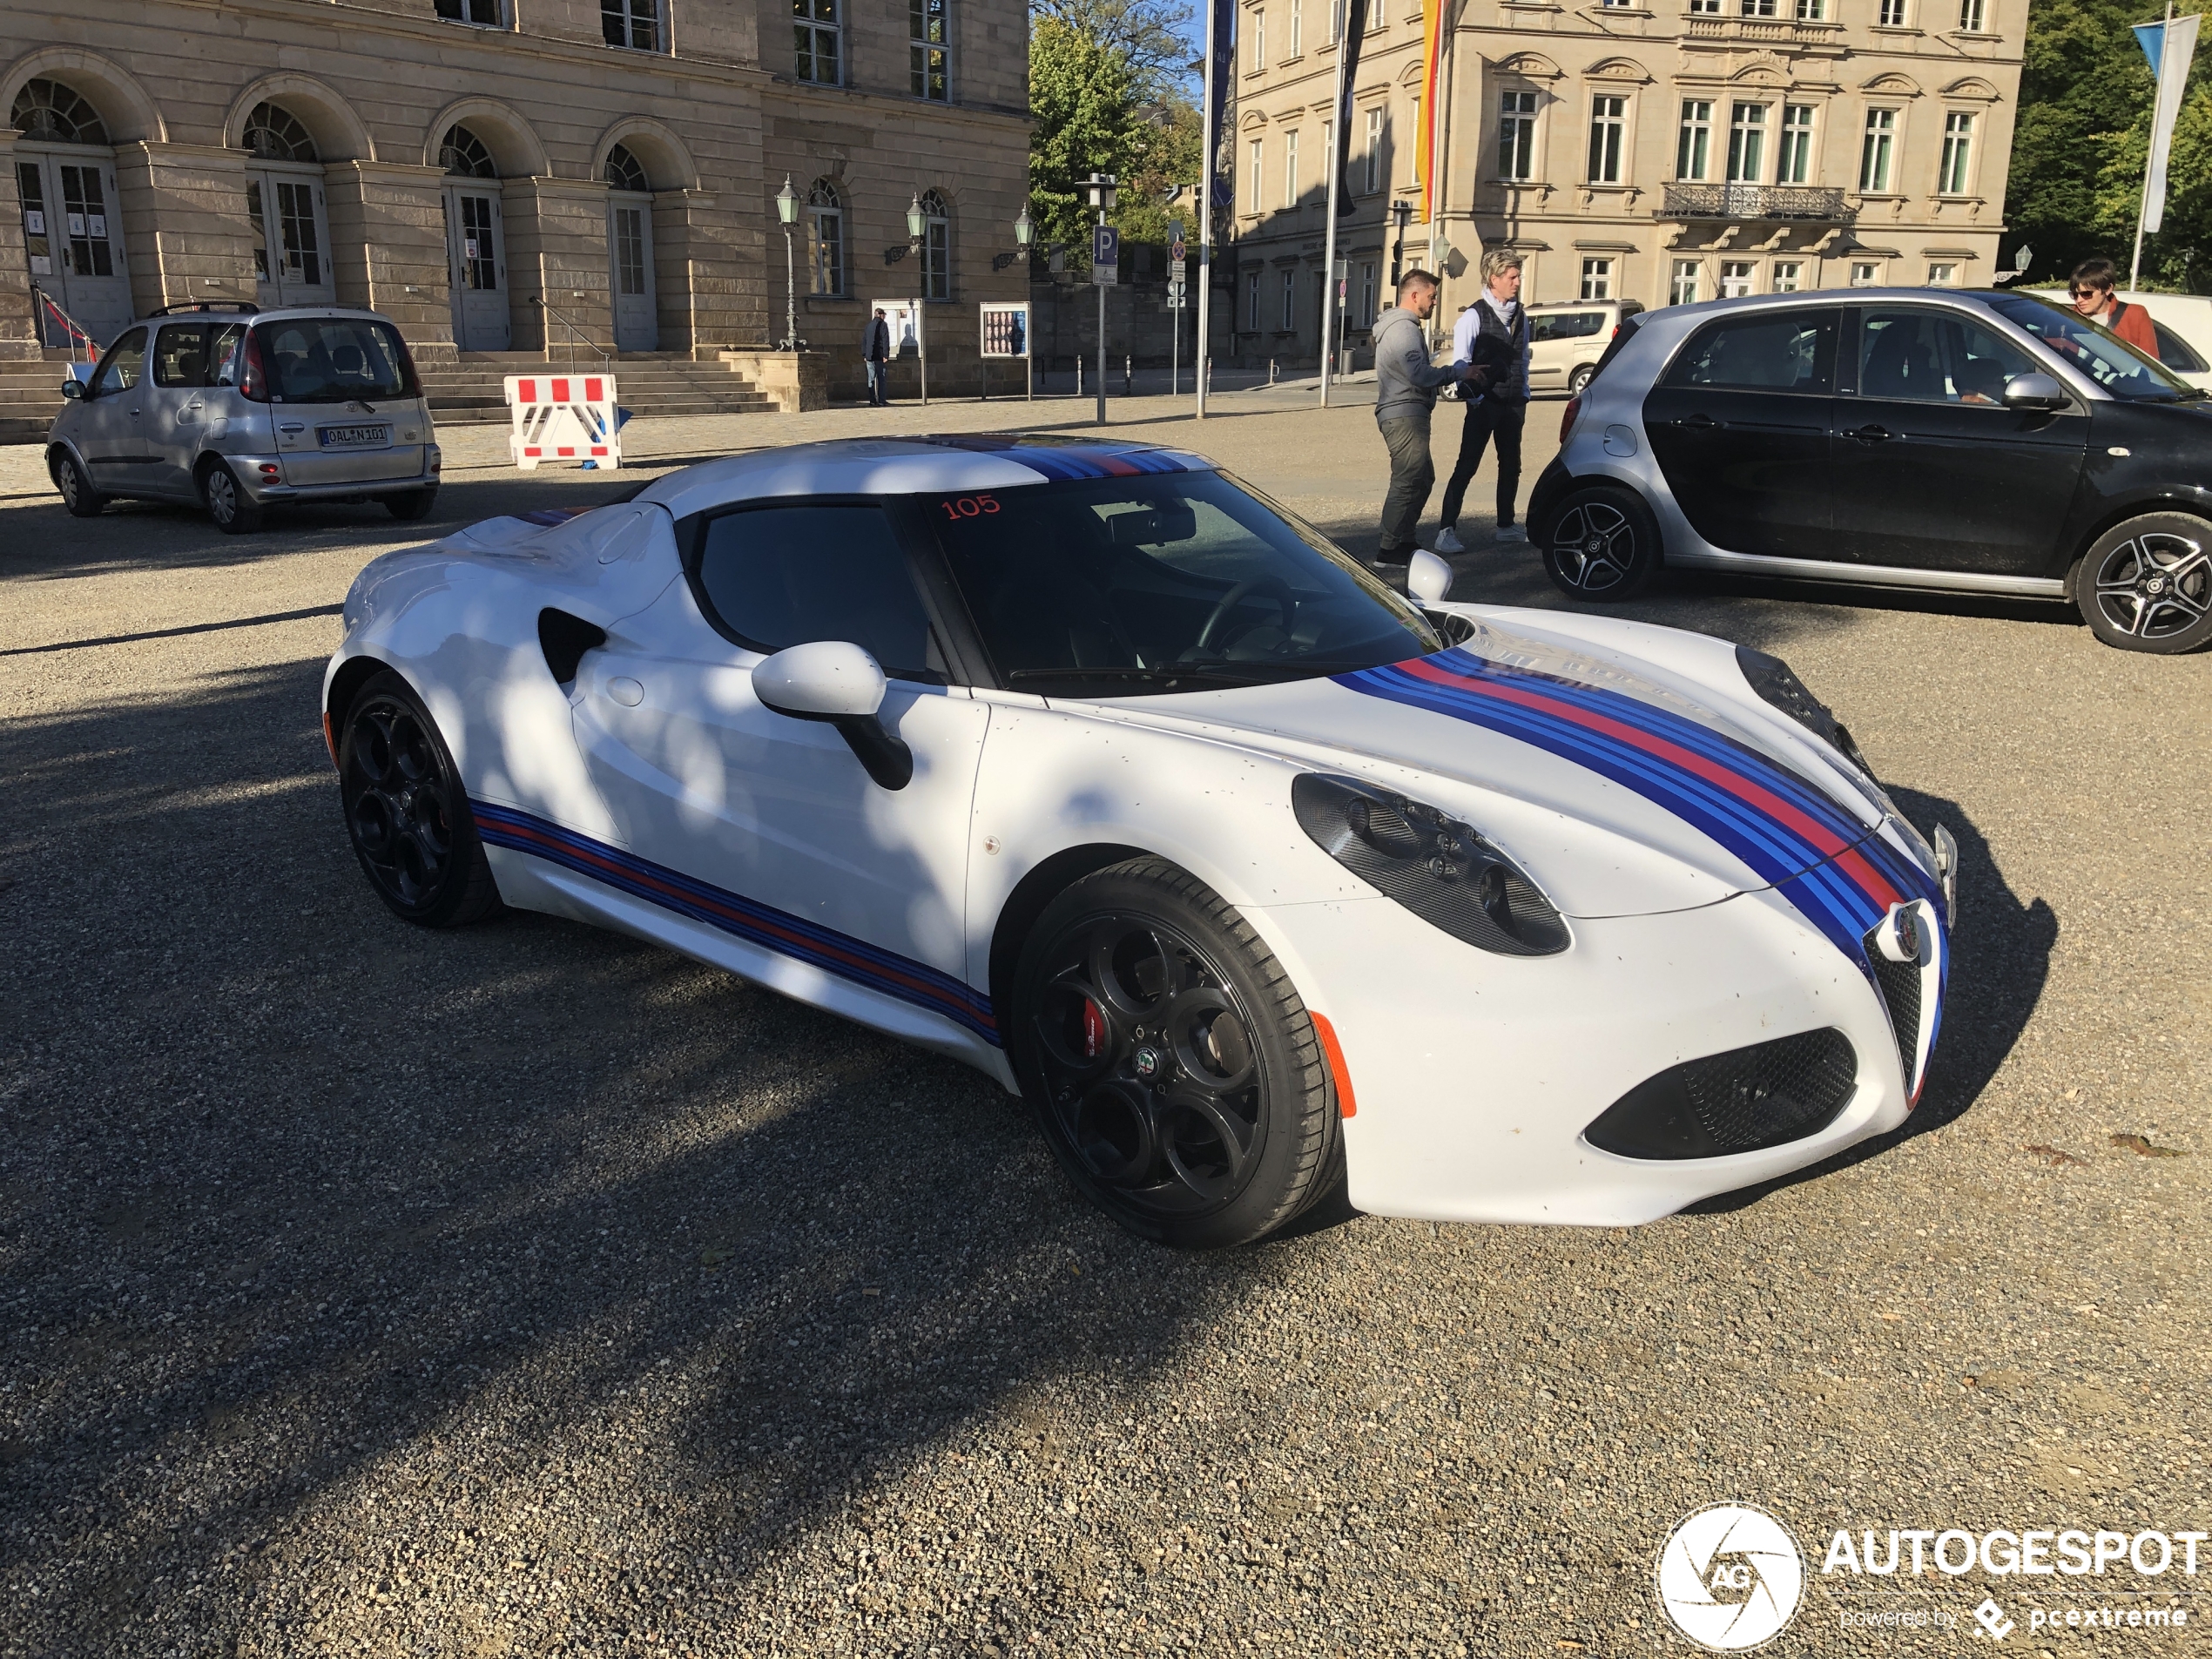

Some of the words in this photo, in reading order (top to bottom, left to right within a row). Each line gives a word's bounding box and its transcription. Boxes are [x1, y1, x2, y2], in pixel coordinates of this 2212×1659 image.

[1099, 231, 1113, 260] P
[329, 430, 351, 442] OAL
[941, 495, 1001, 520] 105
